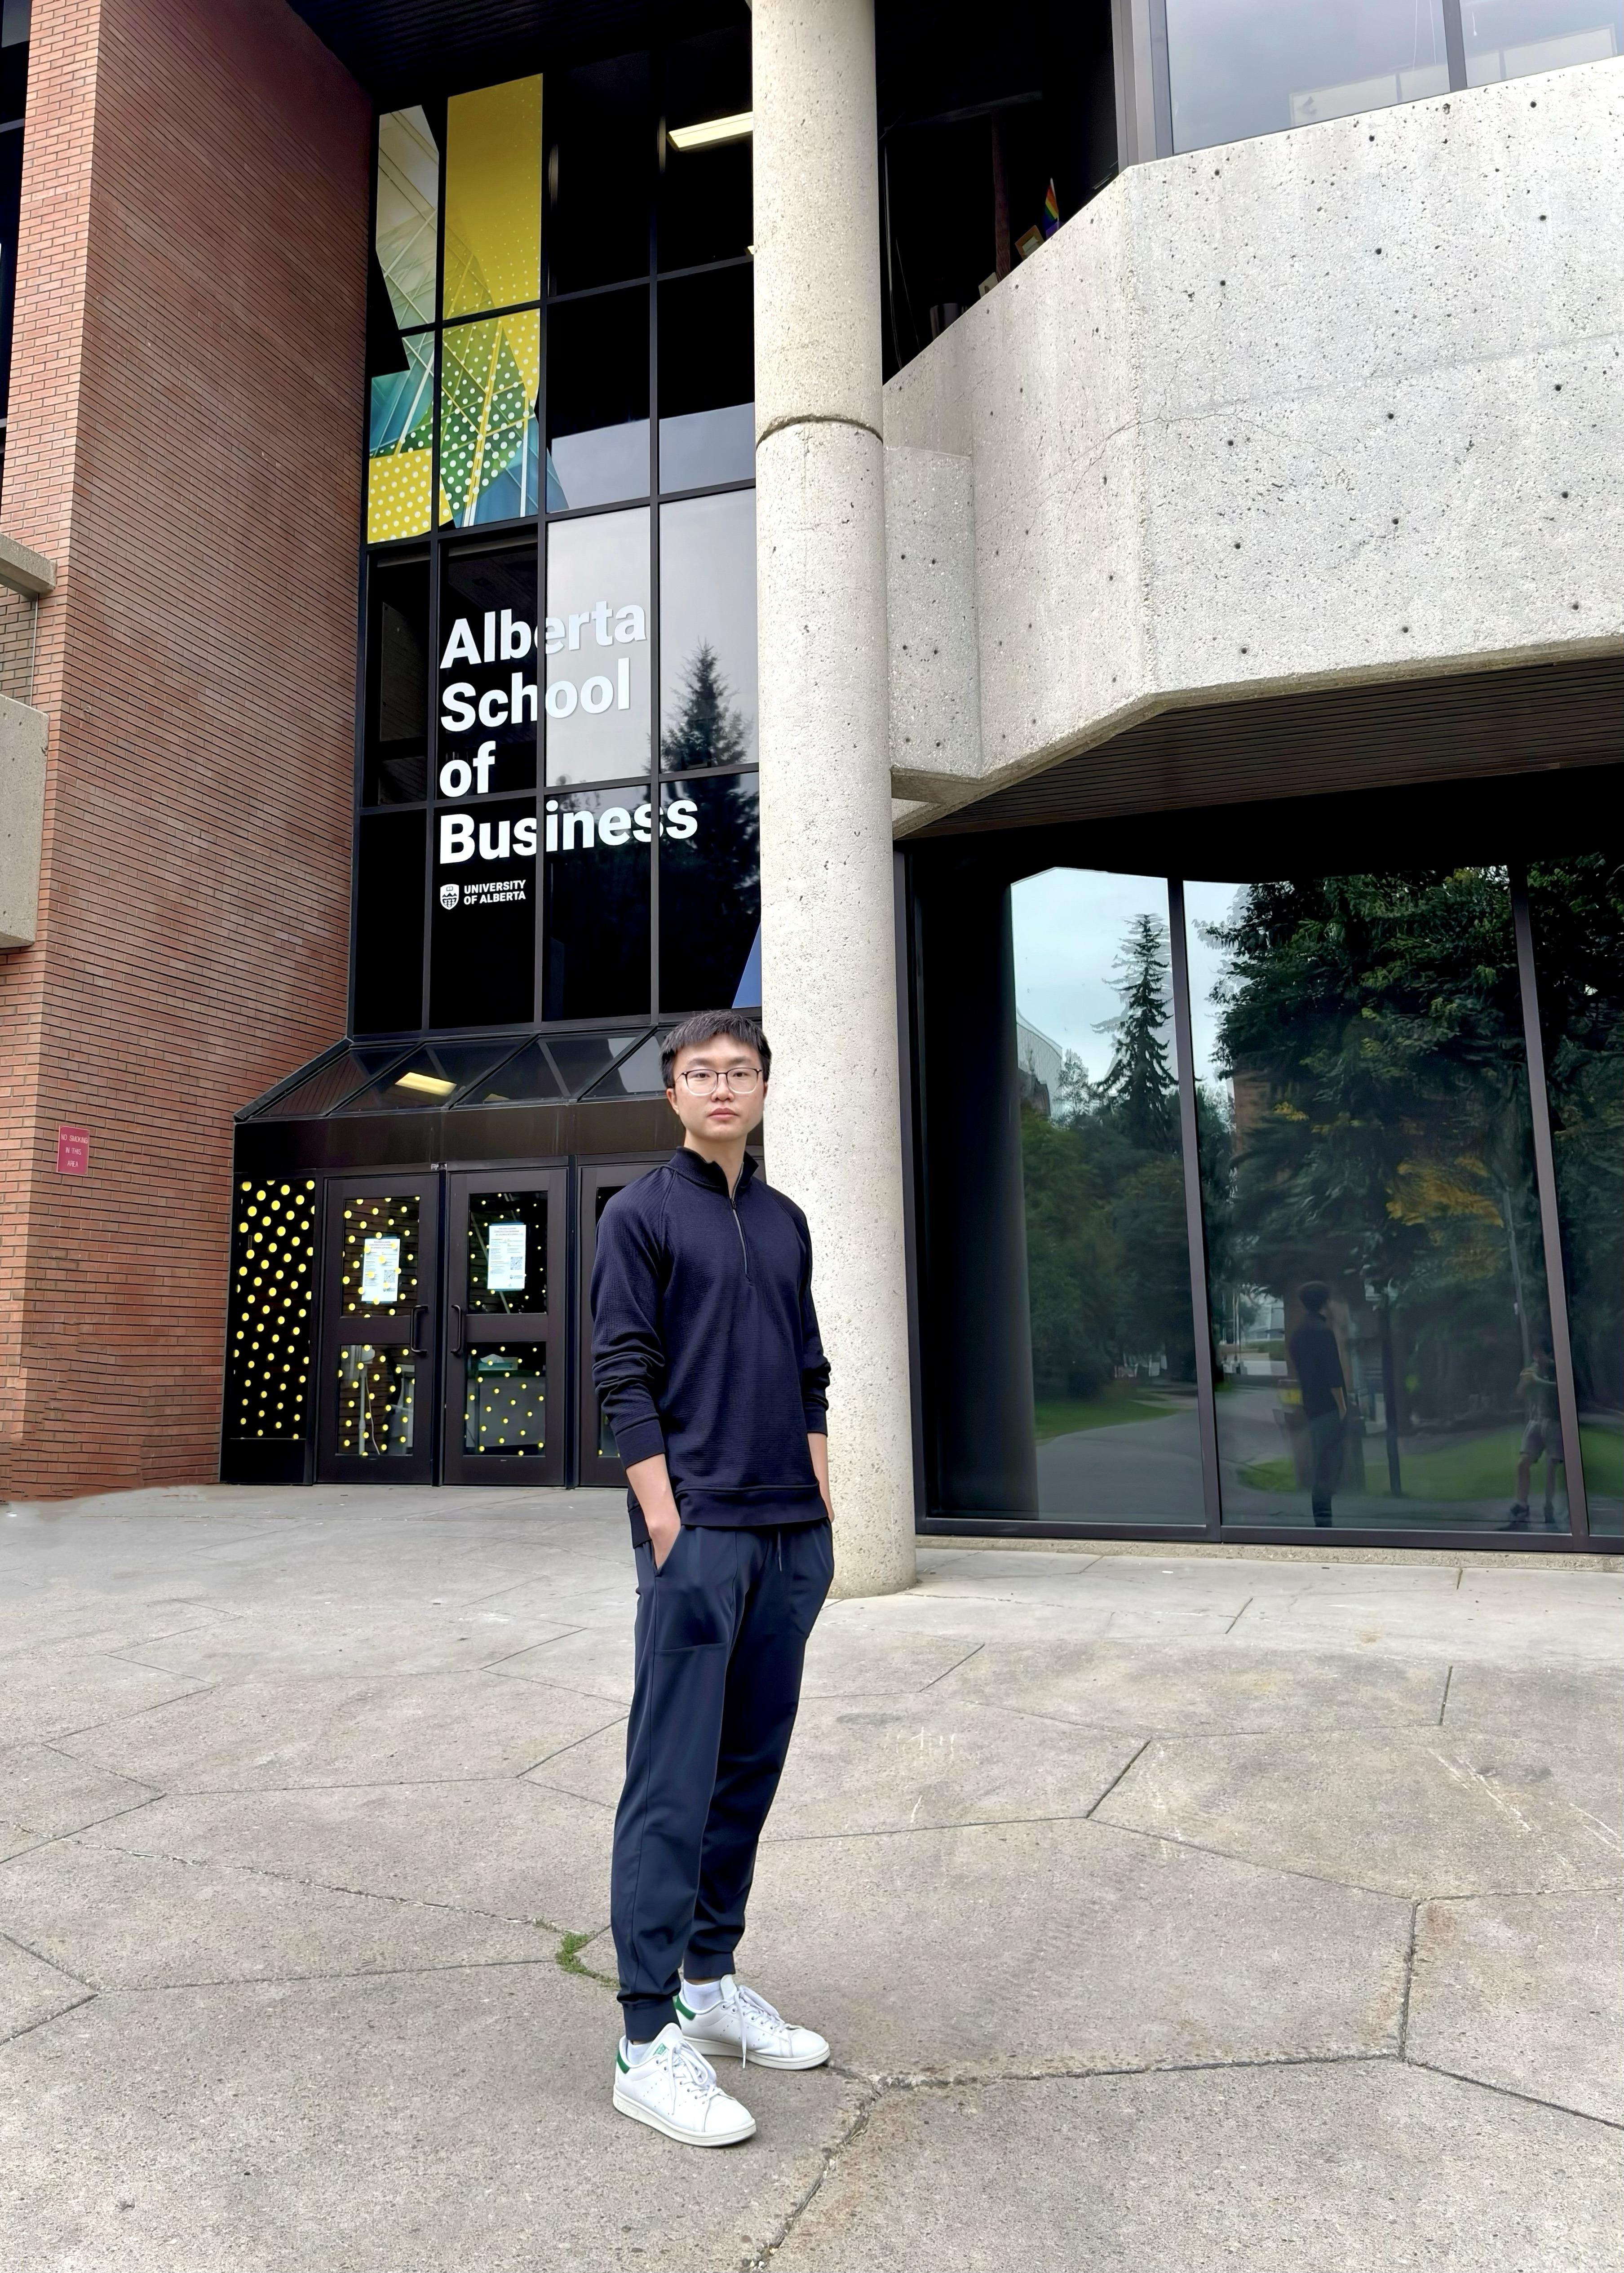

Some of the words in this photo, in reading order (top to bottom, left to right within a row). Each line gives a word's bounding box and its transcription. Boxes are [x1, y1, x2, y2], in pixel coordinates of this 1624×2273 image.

[440, 600, 647, 669] Alberta
[441, 657, 630, 731] School
[439, 740, 496, 798] of
[440, 800, 698, 864] Business
[464, 879, 526, 894] UNIVERSITY
[464, 895, 478, 904] OF
[479, 891, 526, 904] ALBERTA
[69, 1135, 88, 1143] SMOKING
